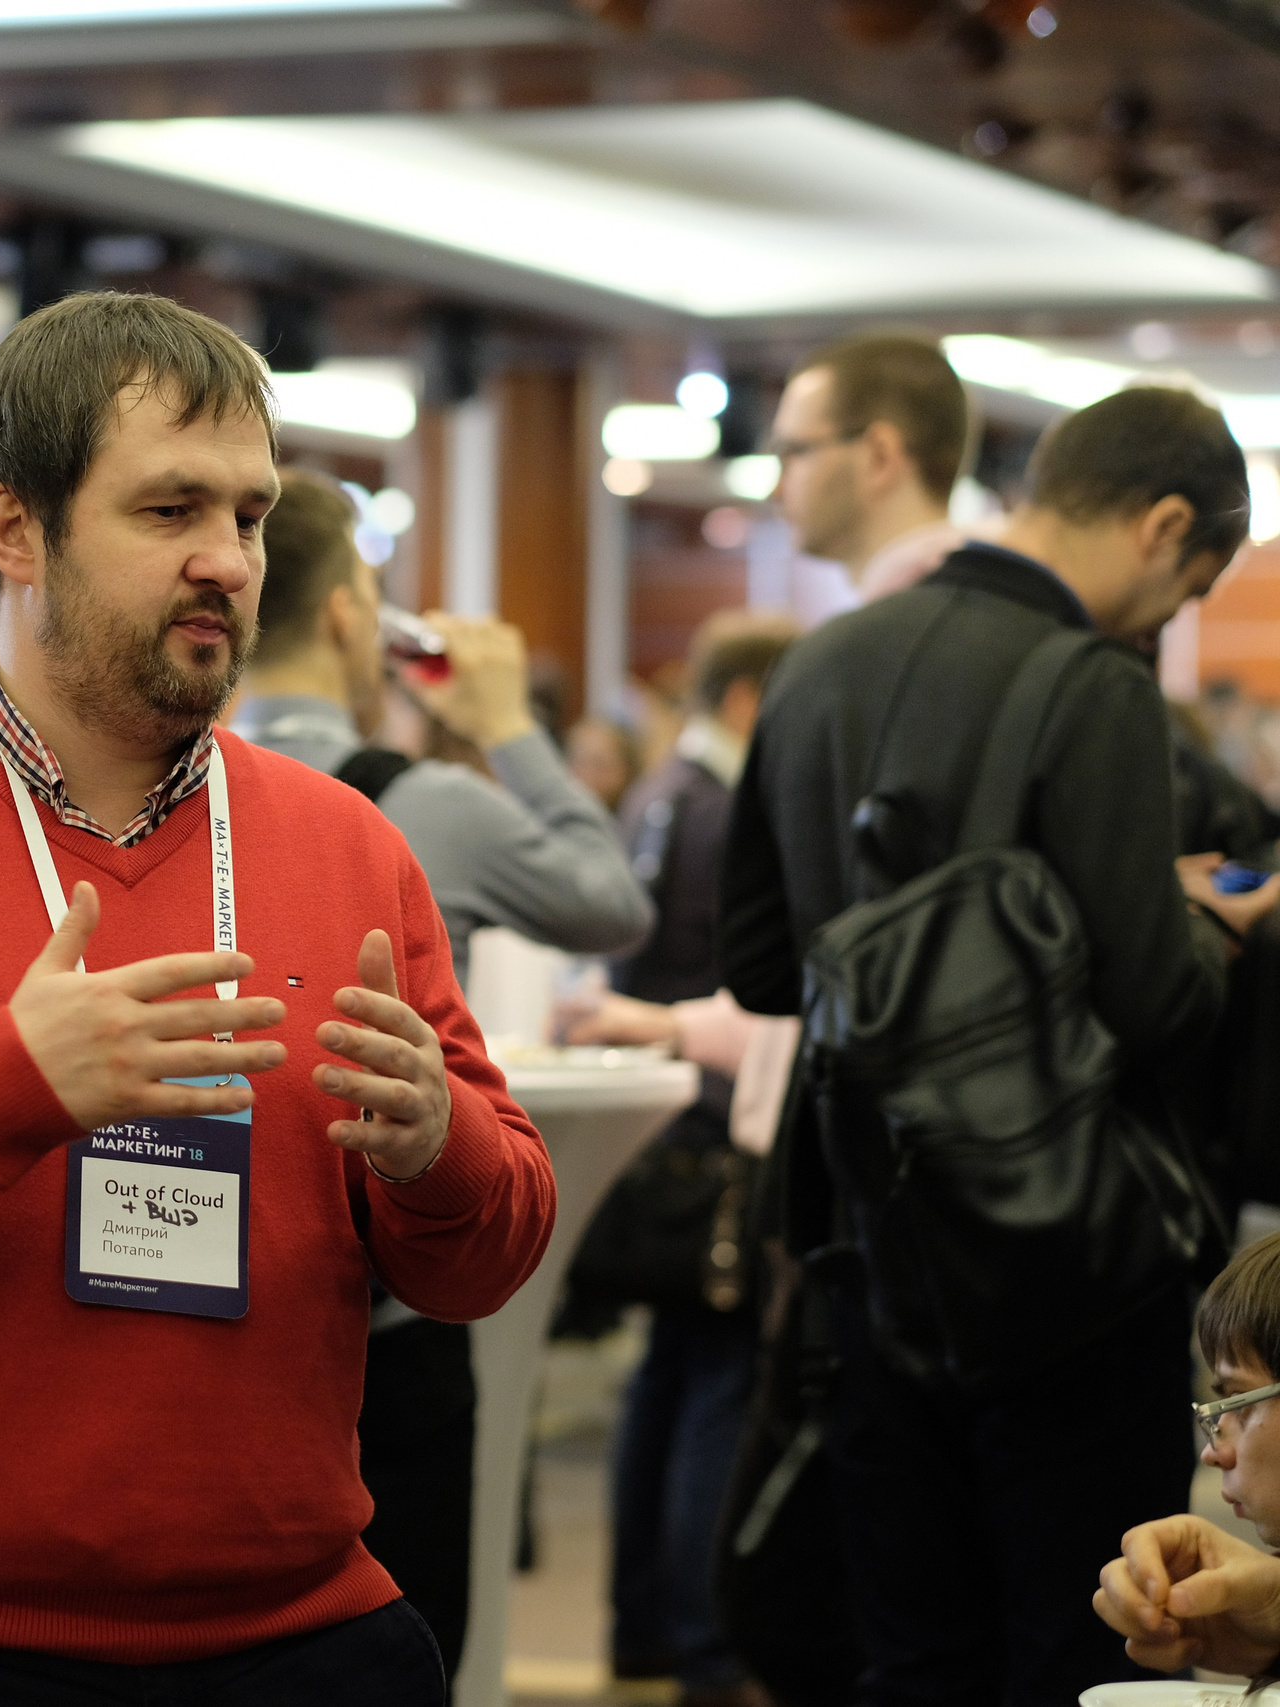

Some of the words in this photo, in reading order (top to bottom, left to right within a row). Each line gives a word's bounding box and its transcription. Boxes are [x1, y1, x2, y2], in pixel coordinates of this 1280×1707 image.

[218, 887, 232, 952] МАРКЕТ
[91, 1136, 186, 1159] МАРКЕТИНГ
[189, 1148, 204, 1161] 18
[105, 1179, 139, 1198] Out
[146, 1185, 166, 1201] of
[172, 1188, 224, 1208] Cloud
[144, 1200, 199, 1226] ВШЭ
[102, 1219, 168, 1240] Дмитрий
[102, 1239, 164, 1259] Потапов
[88, 1278, 159, 1293] #МатеМаркетинг
